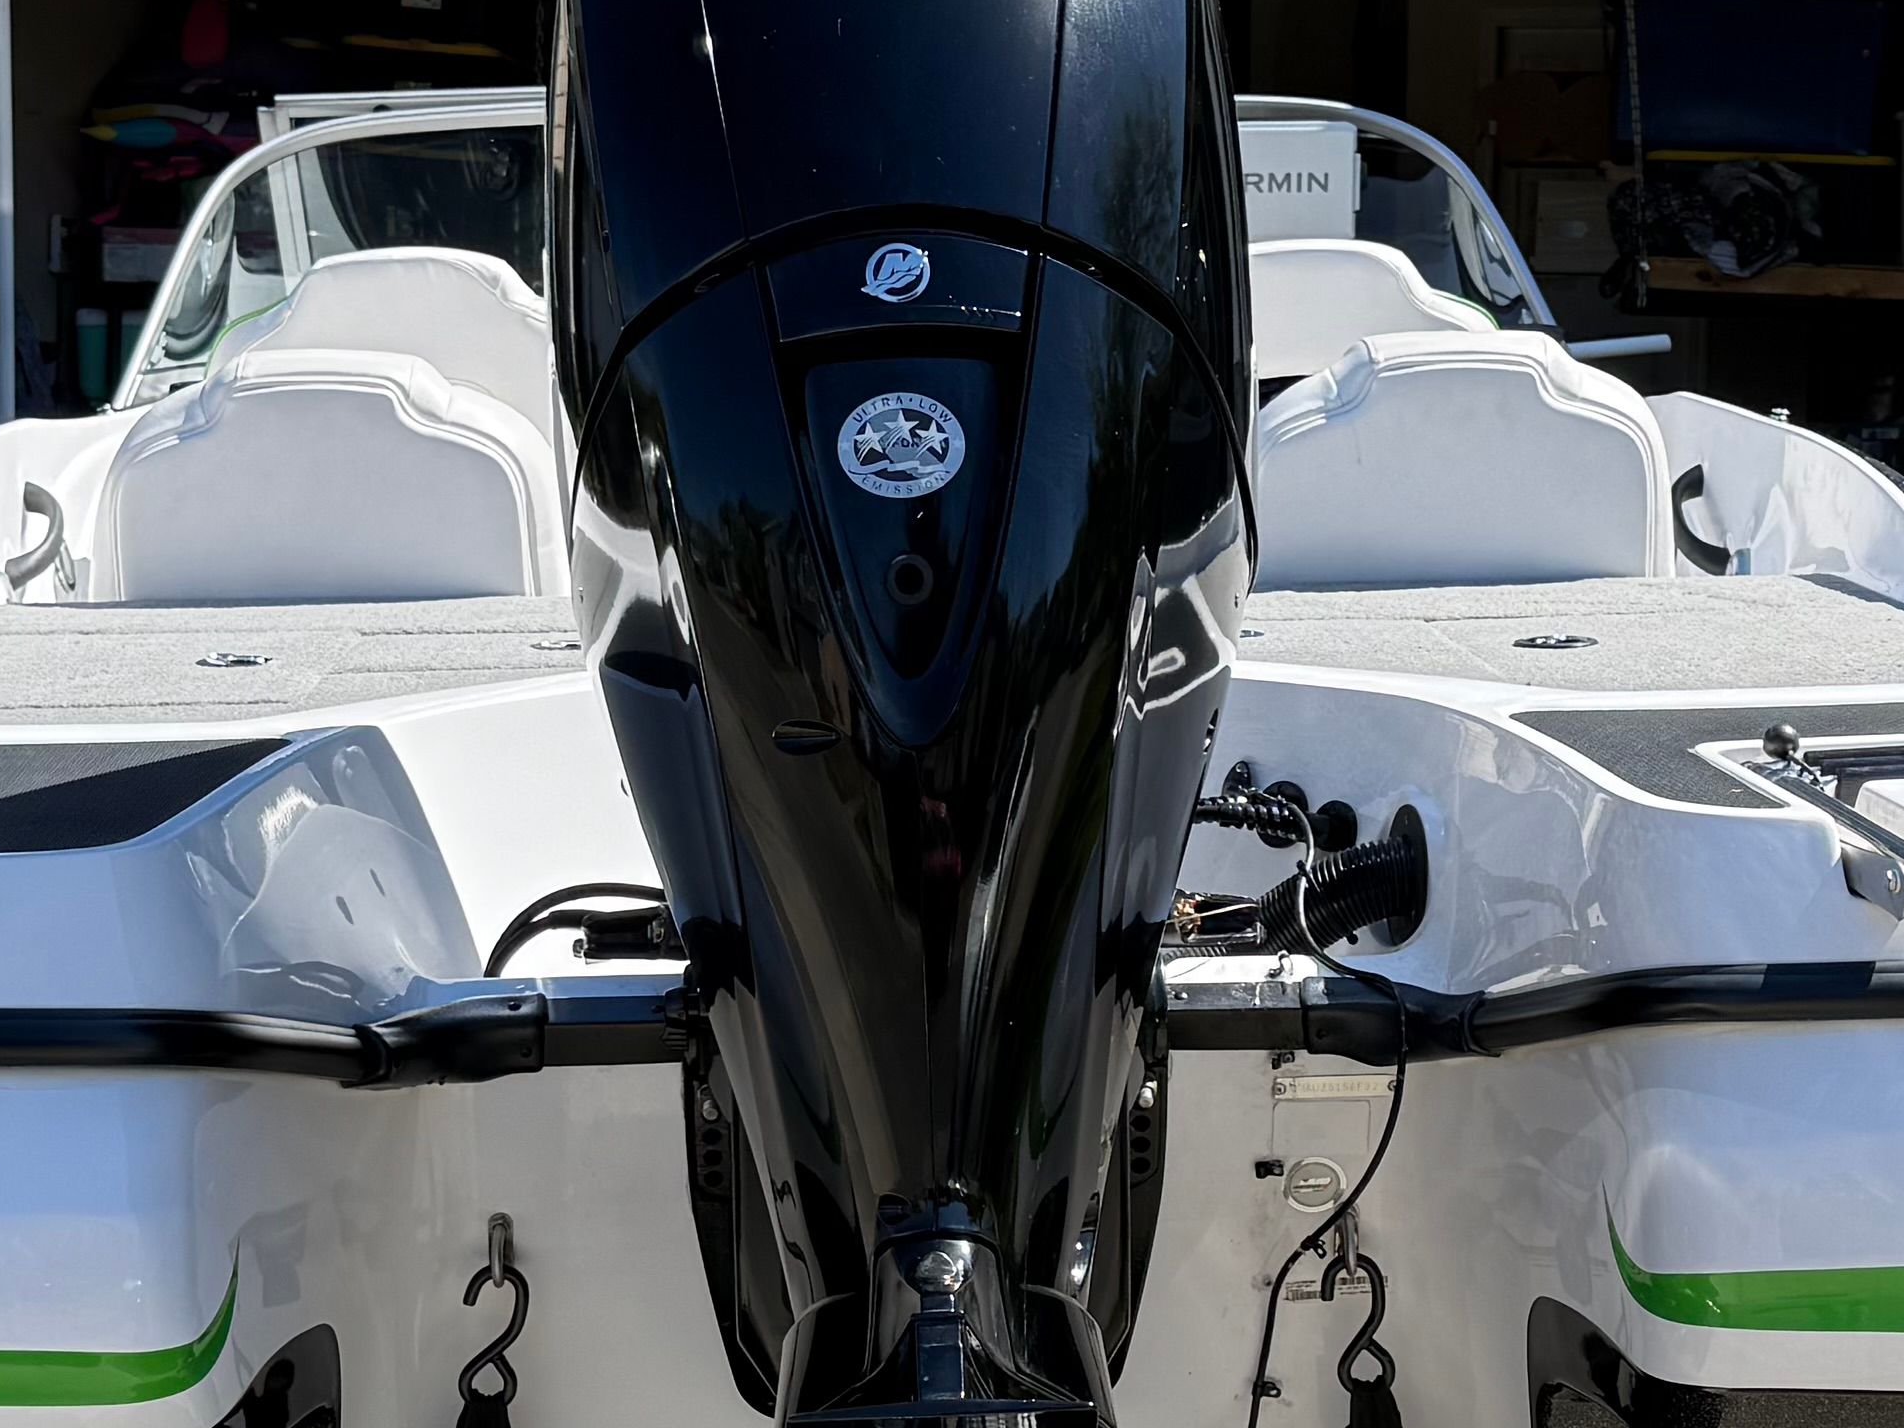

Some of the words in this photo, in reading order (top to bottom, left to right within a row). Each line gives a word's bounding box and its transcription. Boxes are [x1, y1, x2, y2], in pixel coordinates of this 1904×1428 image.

[1244, 172, 1329, 193] RMIN
[853, 395, 903, 424] ULTRA
[919, 398, 952, 424] LOW
[861, 473, 945, 494] EMISSION
